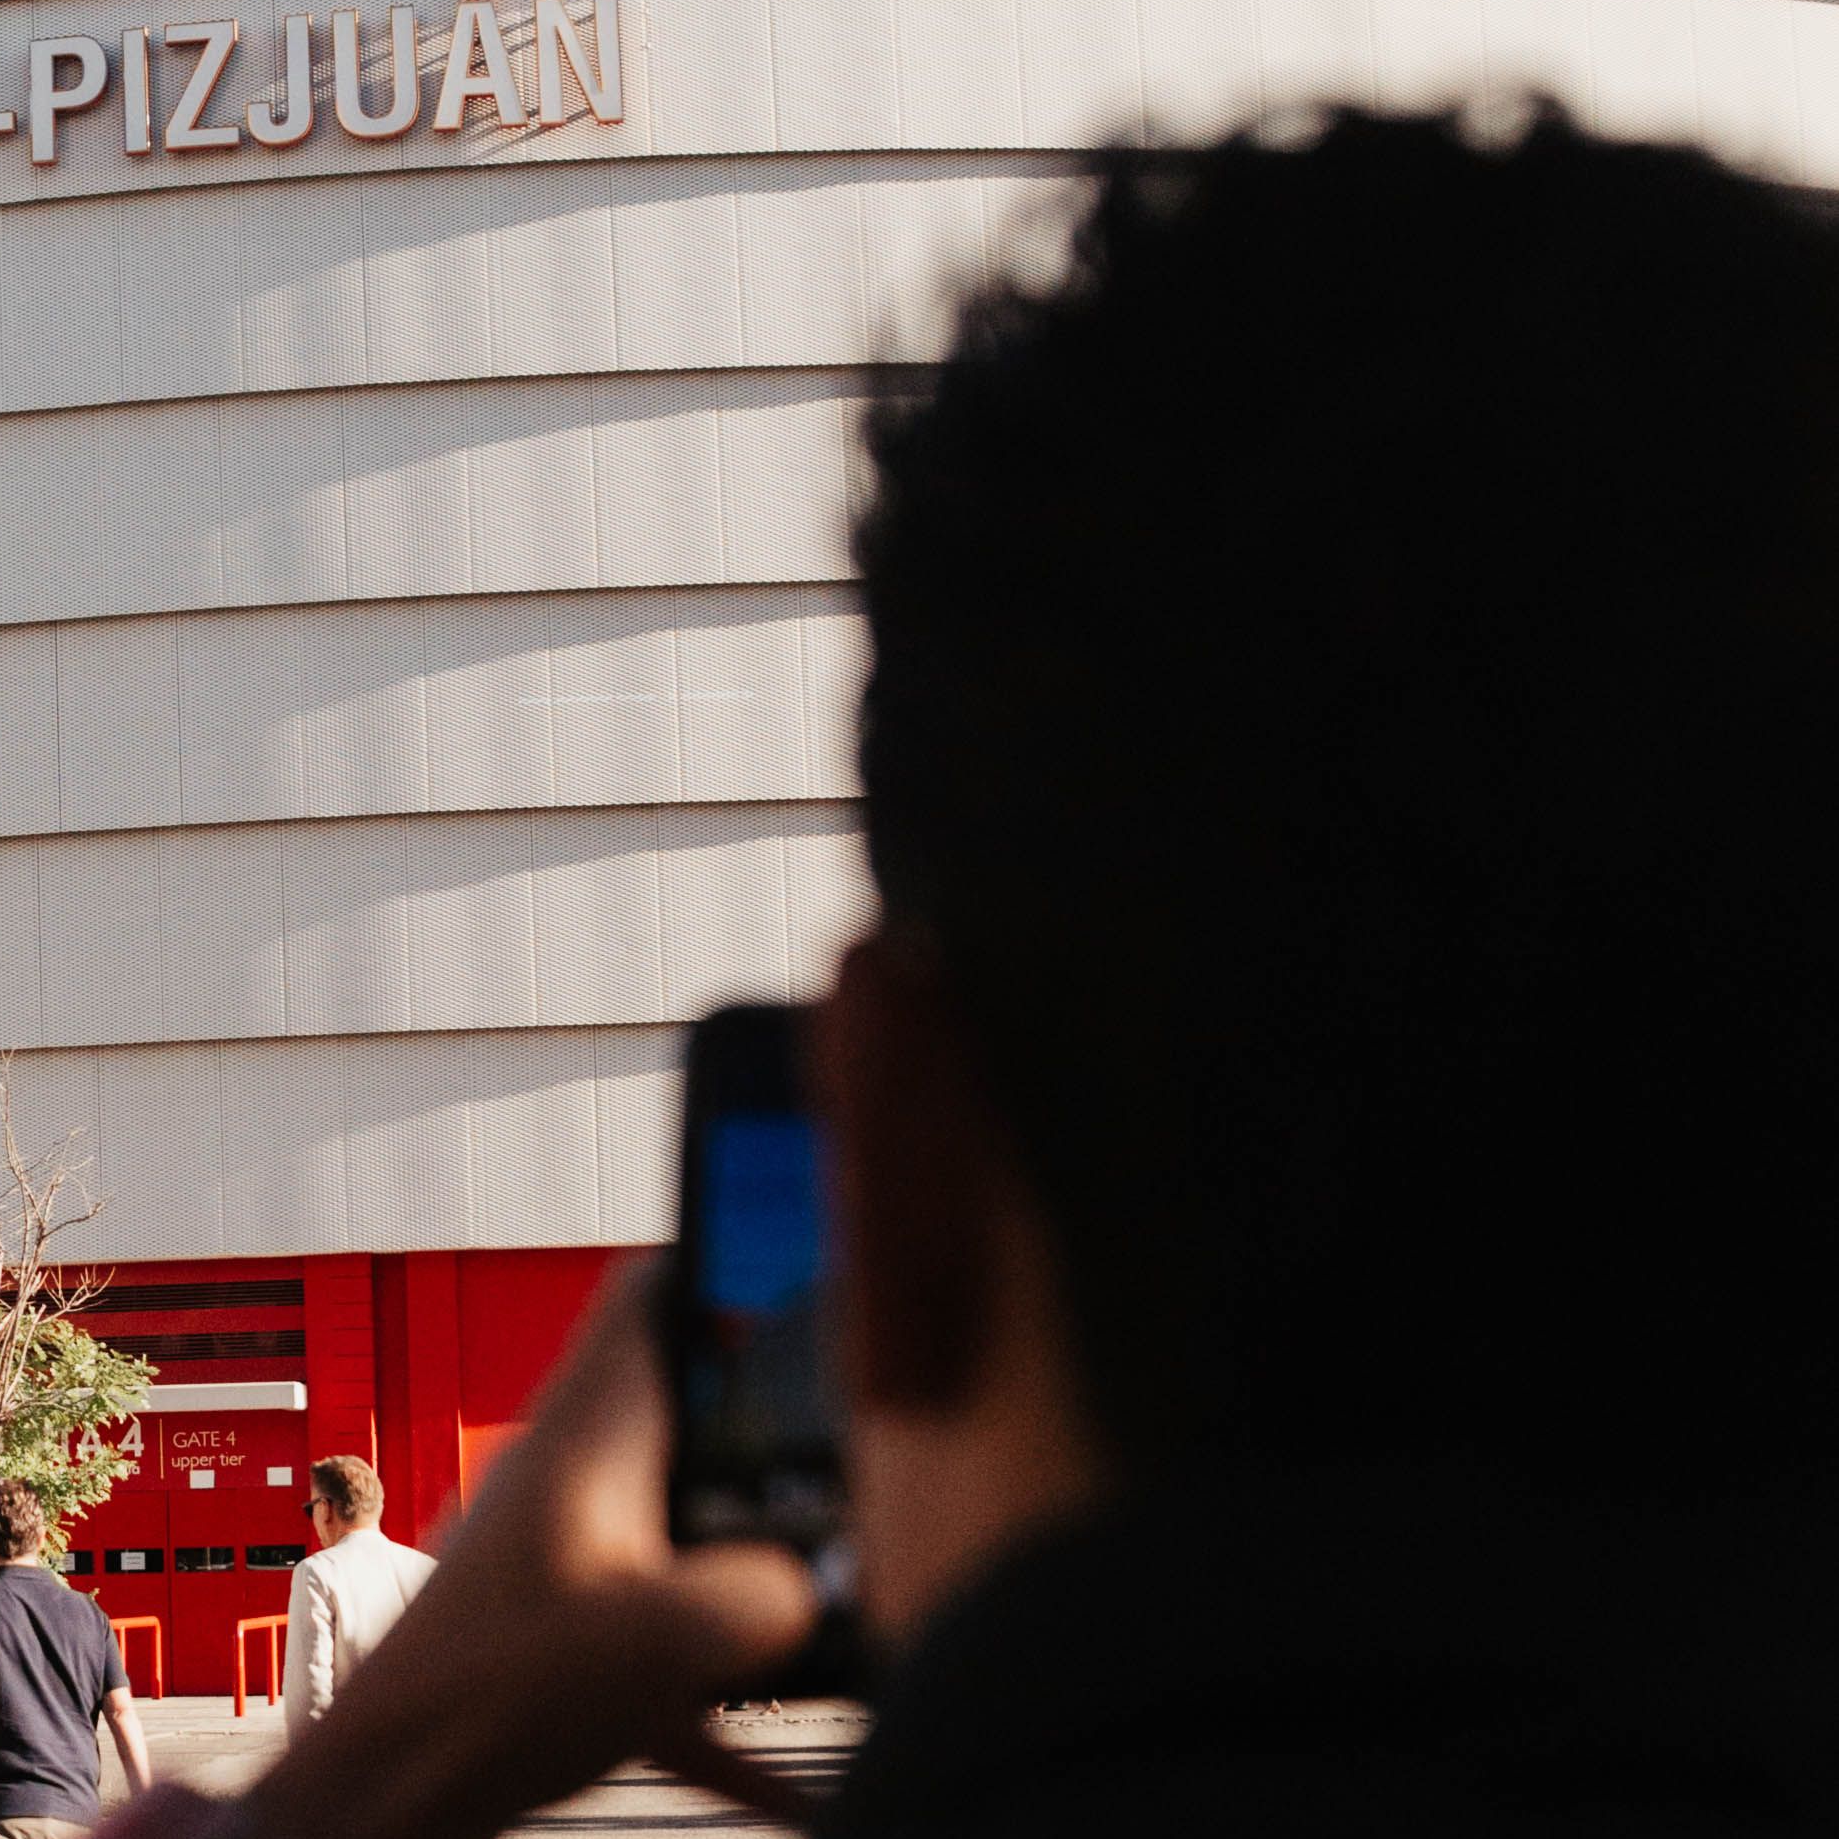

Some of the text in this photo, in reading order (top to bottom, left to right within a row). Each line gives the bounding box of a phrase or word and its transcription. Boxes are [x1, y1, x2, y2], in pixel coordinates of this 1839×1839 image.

[117, 1422, 145, 1458] 4
[172, 1430, 237, 1449] GATE 4
[171, 1451, 245, 1472] upper tier
